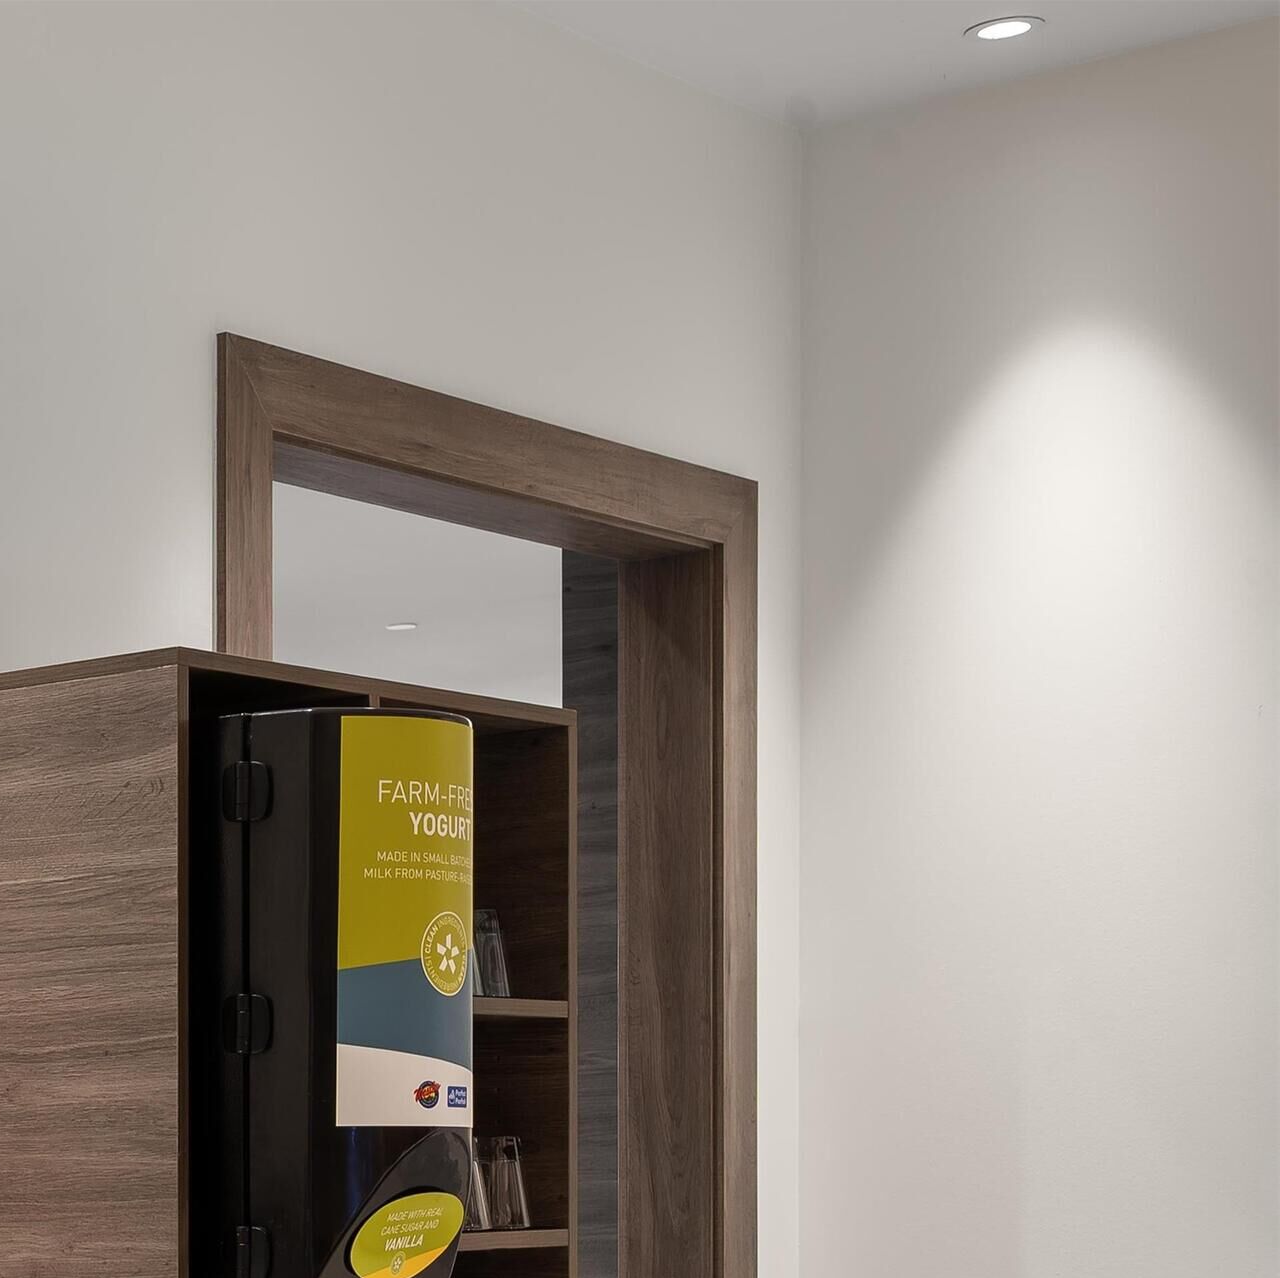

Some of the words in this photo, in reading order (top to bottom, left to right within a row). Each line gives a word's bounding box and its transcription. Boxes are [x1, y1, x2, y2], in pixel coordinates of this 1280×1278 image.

[408, 811, 472, 840] YOGURT
[376, 851, 408, 862] MADE
[410, 852, 421, 862] IN
[422, 852, 449, 865] SMALL
[363, 868, 393, 879] MILK
[395, 868, 423, 880] FROM
[386, 1210, 409, 1222] MADE
[407, 1207, 427, 1220] WITH
[426, 1207, 444, 1217] REAL
[380, 1223, 401, 1236] CANE
[400, 1221, 425, 1233] SUGAR
[424, 1219, 440, 1230] AND
[384, 1233, 425, 1252] VANILLA
